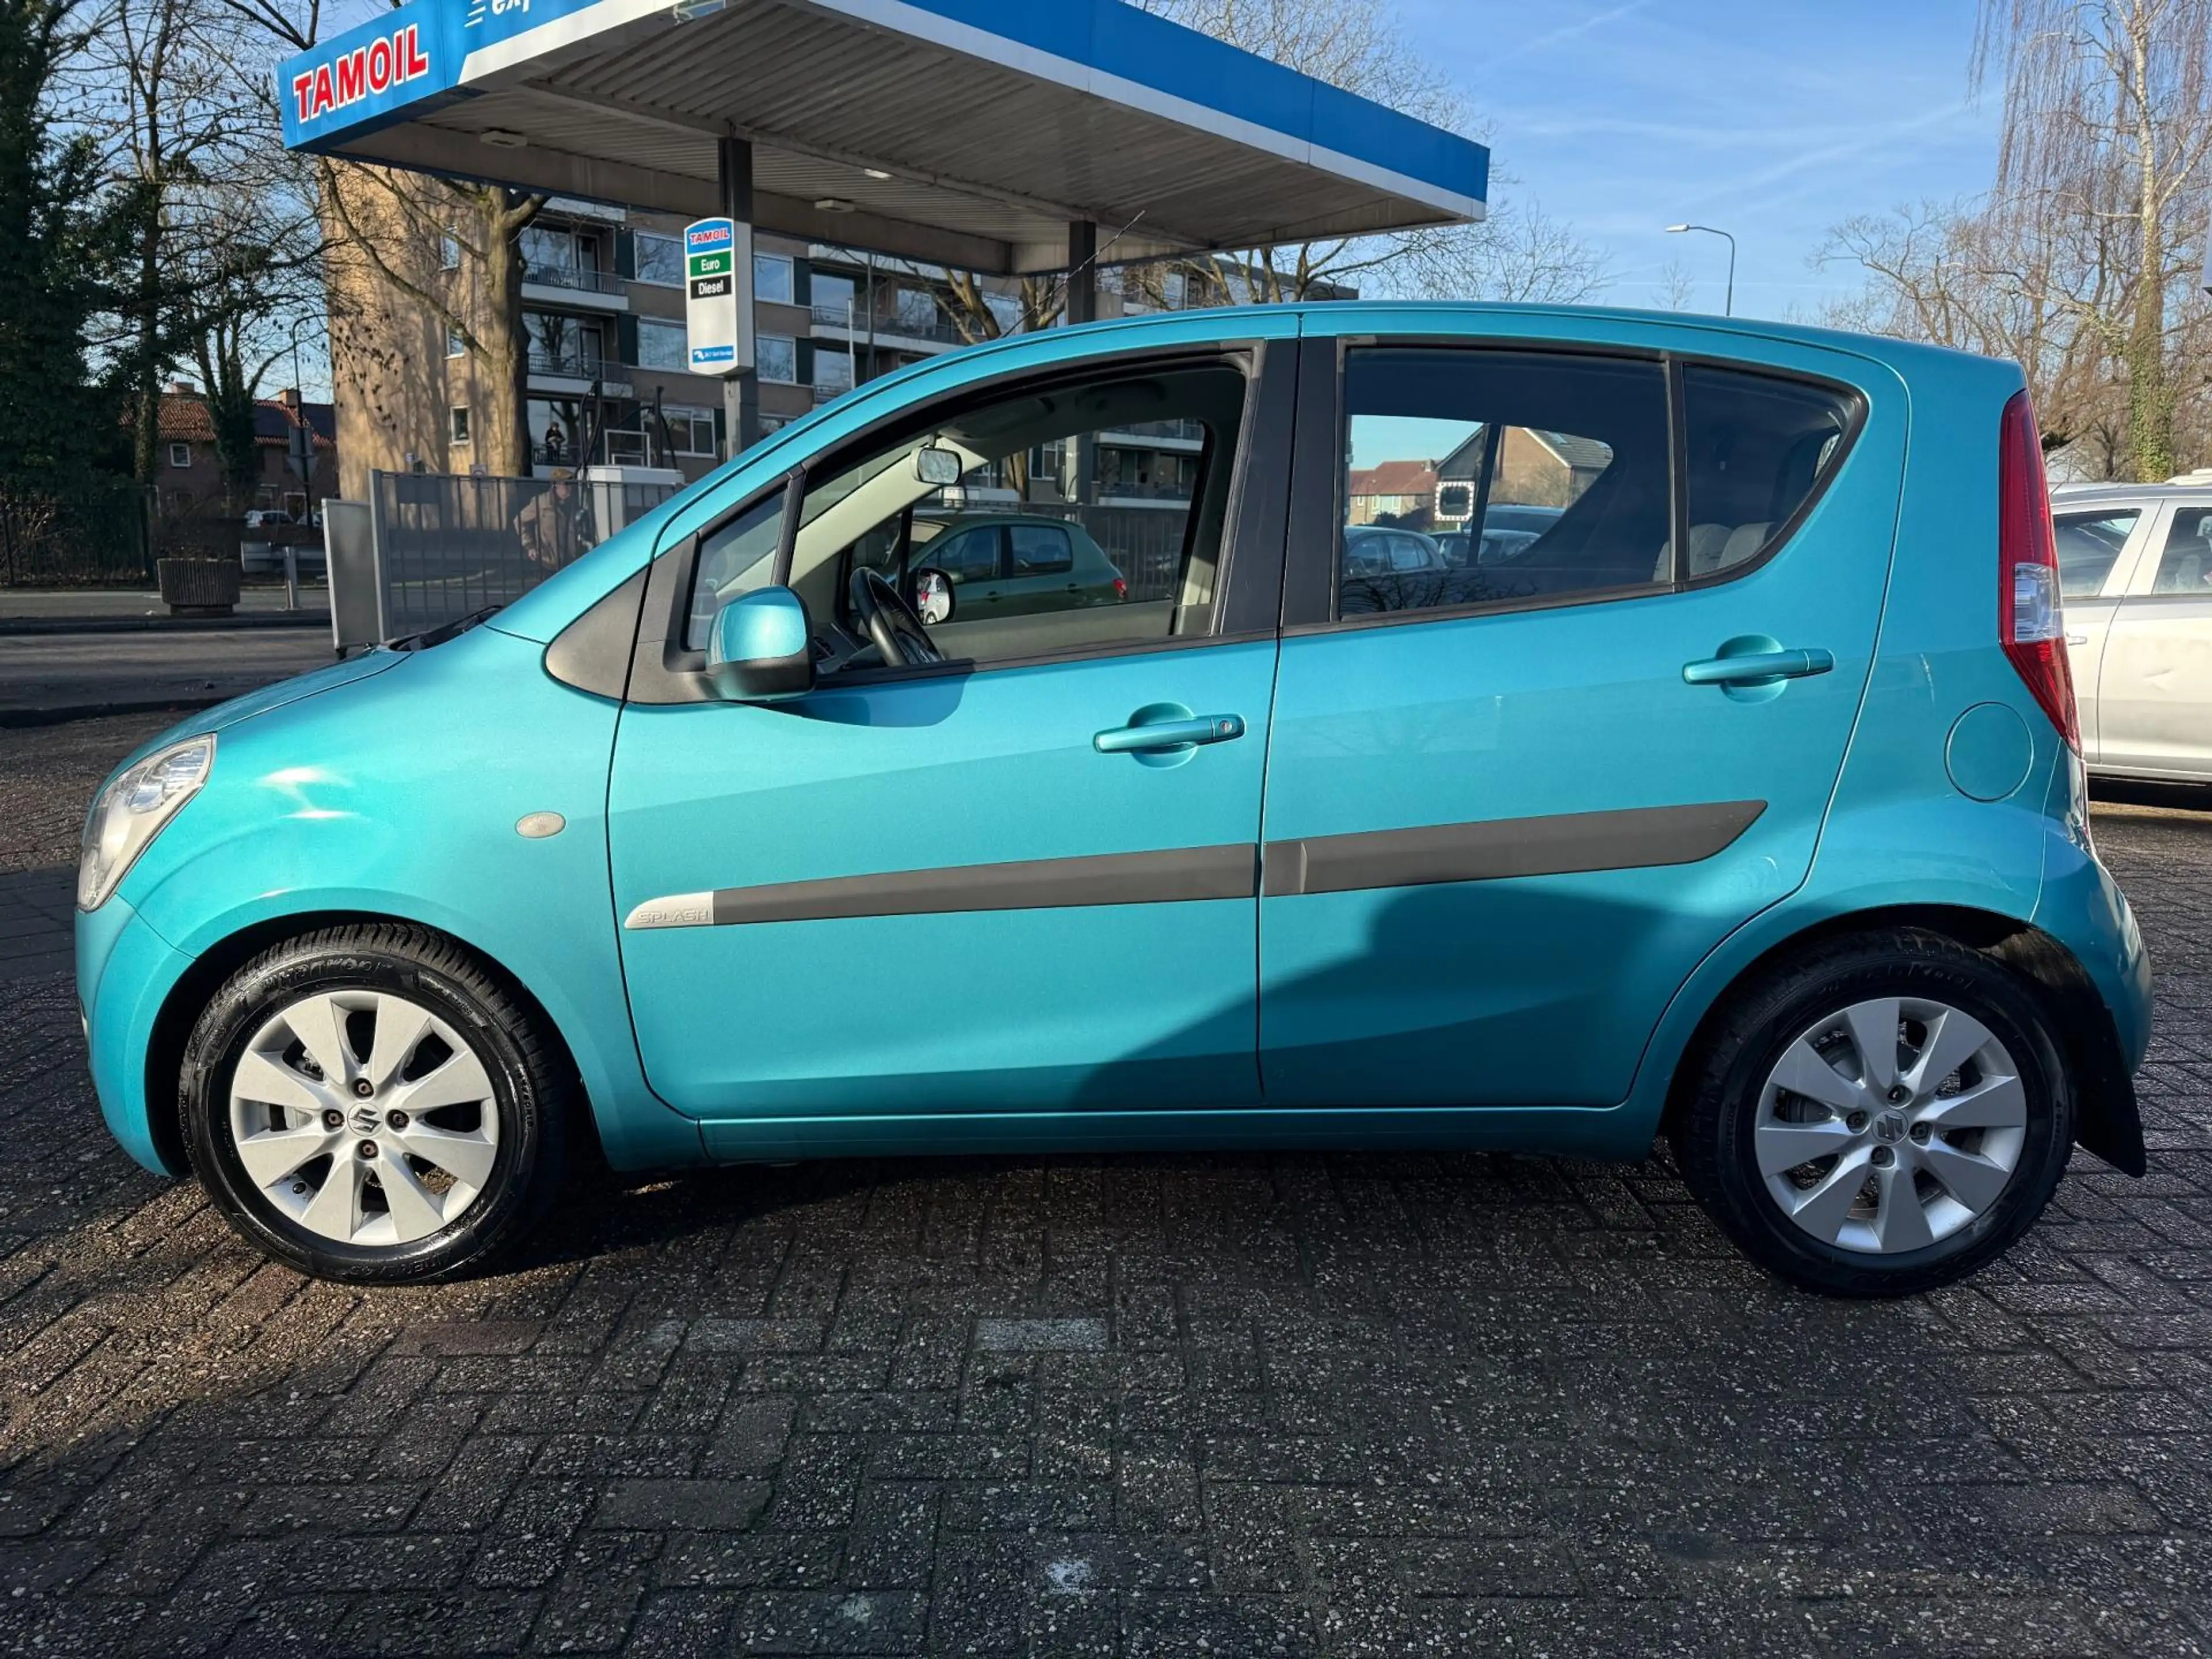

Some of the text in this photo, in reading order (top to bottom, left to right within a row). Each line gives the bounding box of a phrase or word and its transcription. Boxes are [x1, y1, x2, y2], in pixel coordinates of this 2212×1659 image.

[293, 23, 429, 124] TAMOIL
[690, 227, 730, 245] TAMOIL
[700, 259, 720, 271] Euro
[698, 279, 724, 295] Diesel
[638, 908, 709, 924] SPLASH
